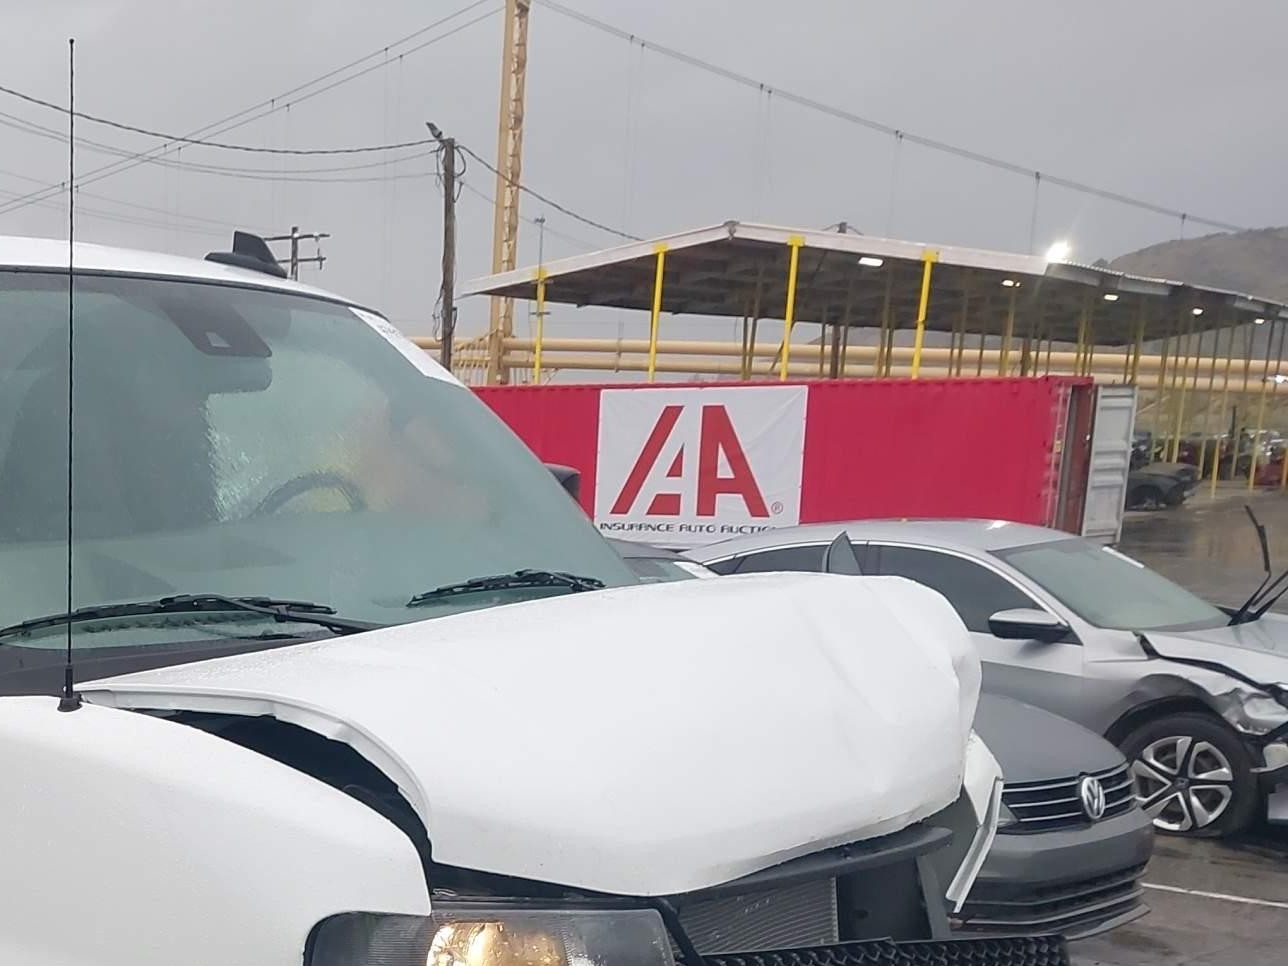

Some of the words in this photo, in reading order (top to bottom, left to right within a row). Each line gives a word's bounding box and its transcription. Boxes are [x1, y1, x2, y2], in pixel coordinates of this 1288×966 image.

[599, 522, 674, 533] INSURANCE
[679, 523, 716, 534] AUTO
[720, 525, 776, 534] AUCTI
